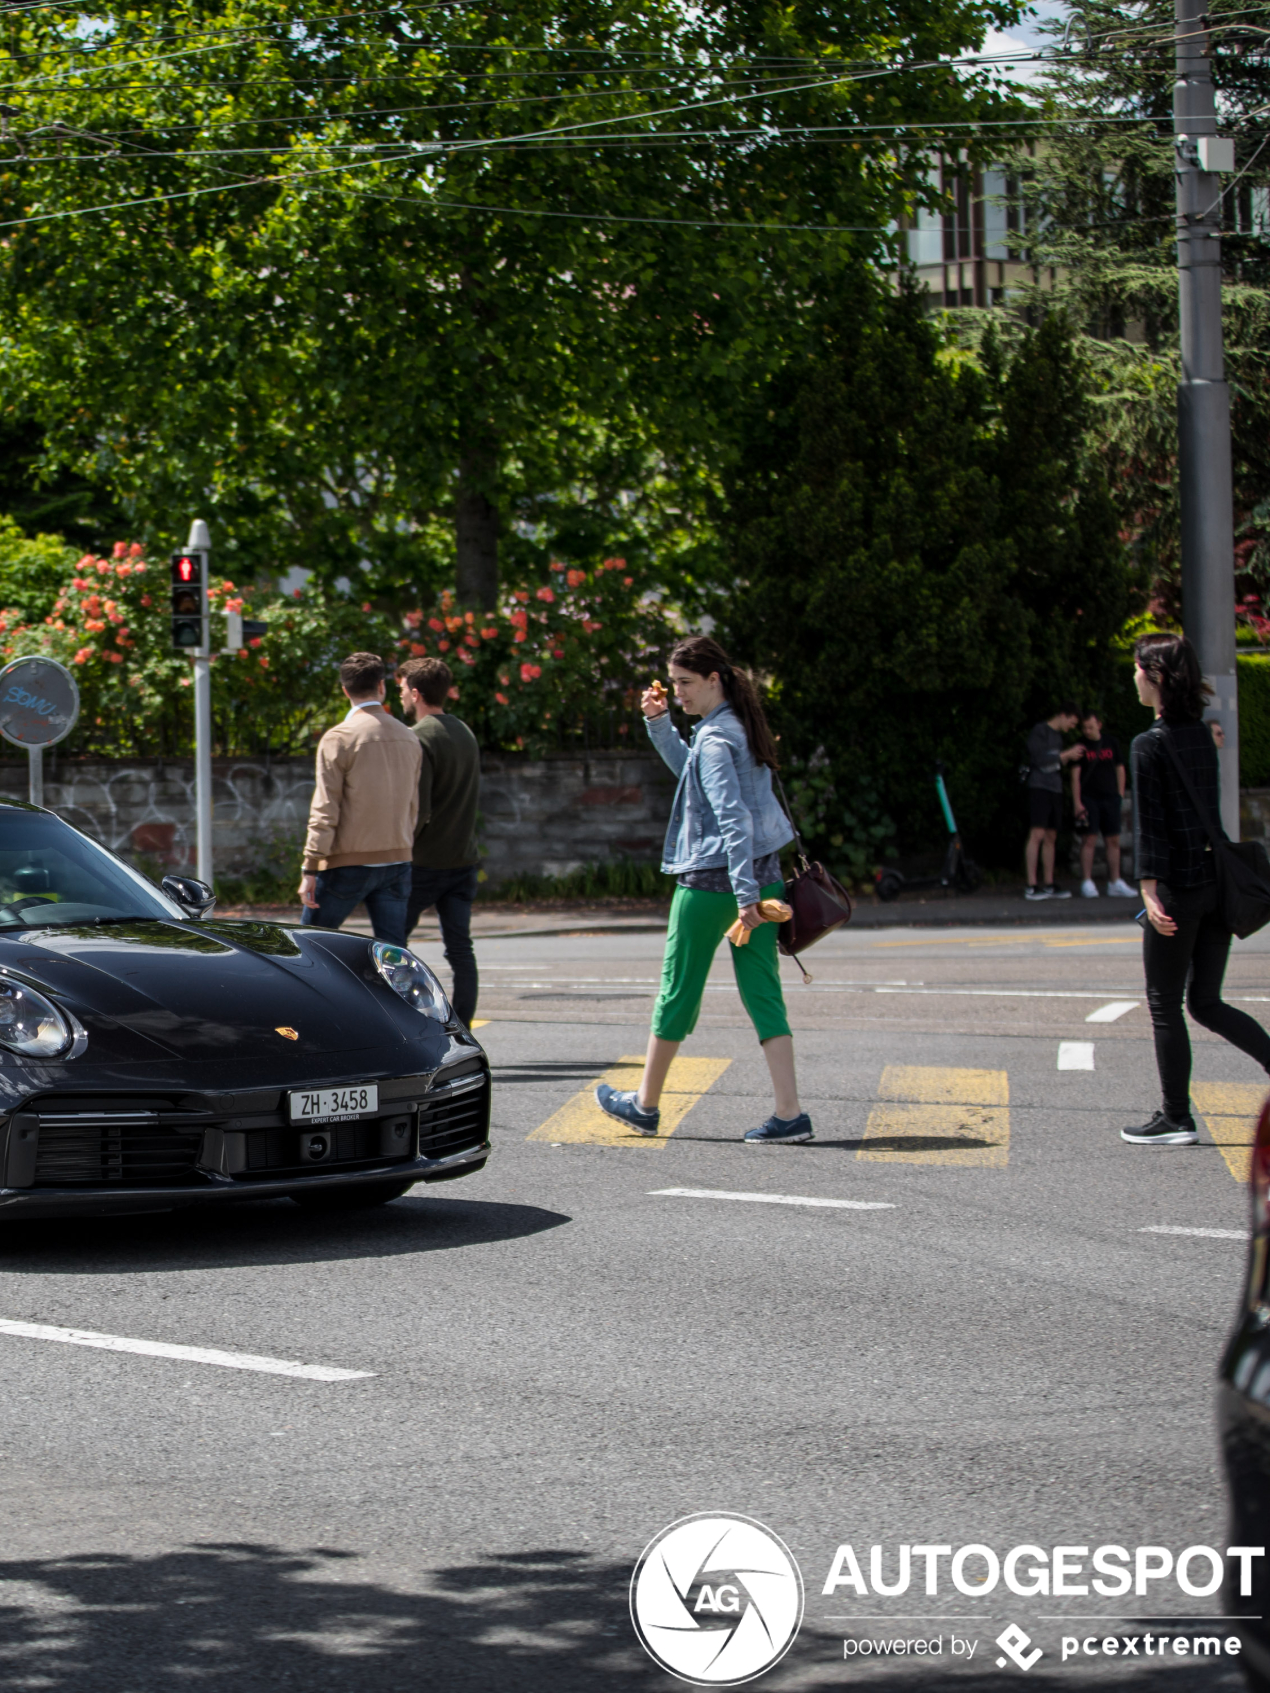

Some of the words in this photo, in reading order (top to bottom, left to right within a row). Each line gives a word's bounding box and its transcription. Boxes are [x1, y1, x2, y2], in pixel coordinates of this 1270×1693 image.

[311, 1116, 329, 1124] EXPERT
[330, 1115, 340, 1123] CAR
[341, 1113, 360, 1121] BROKER
